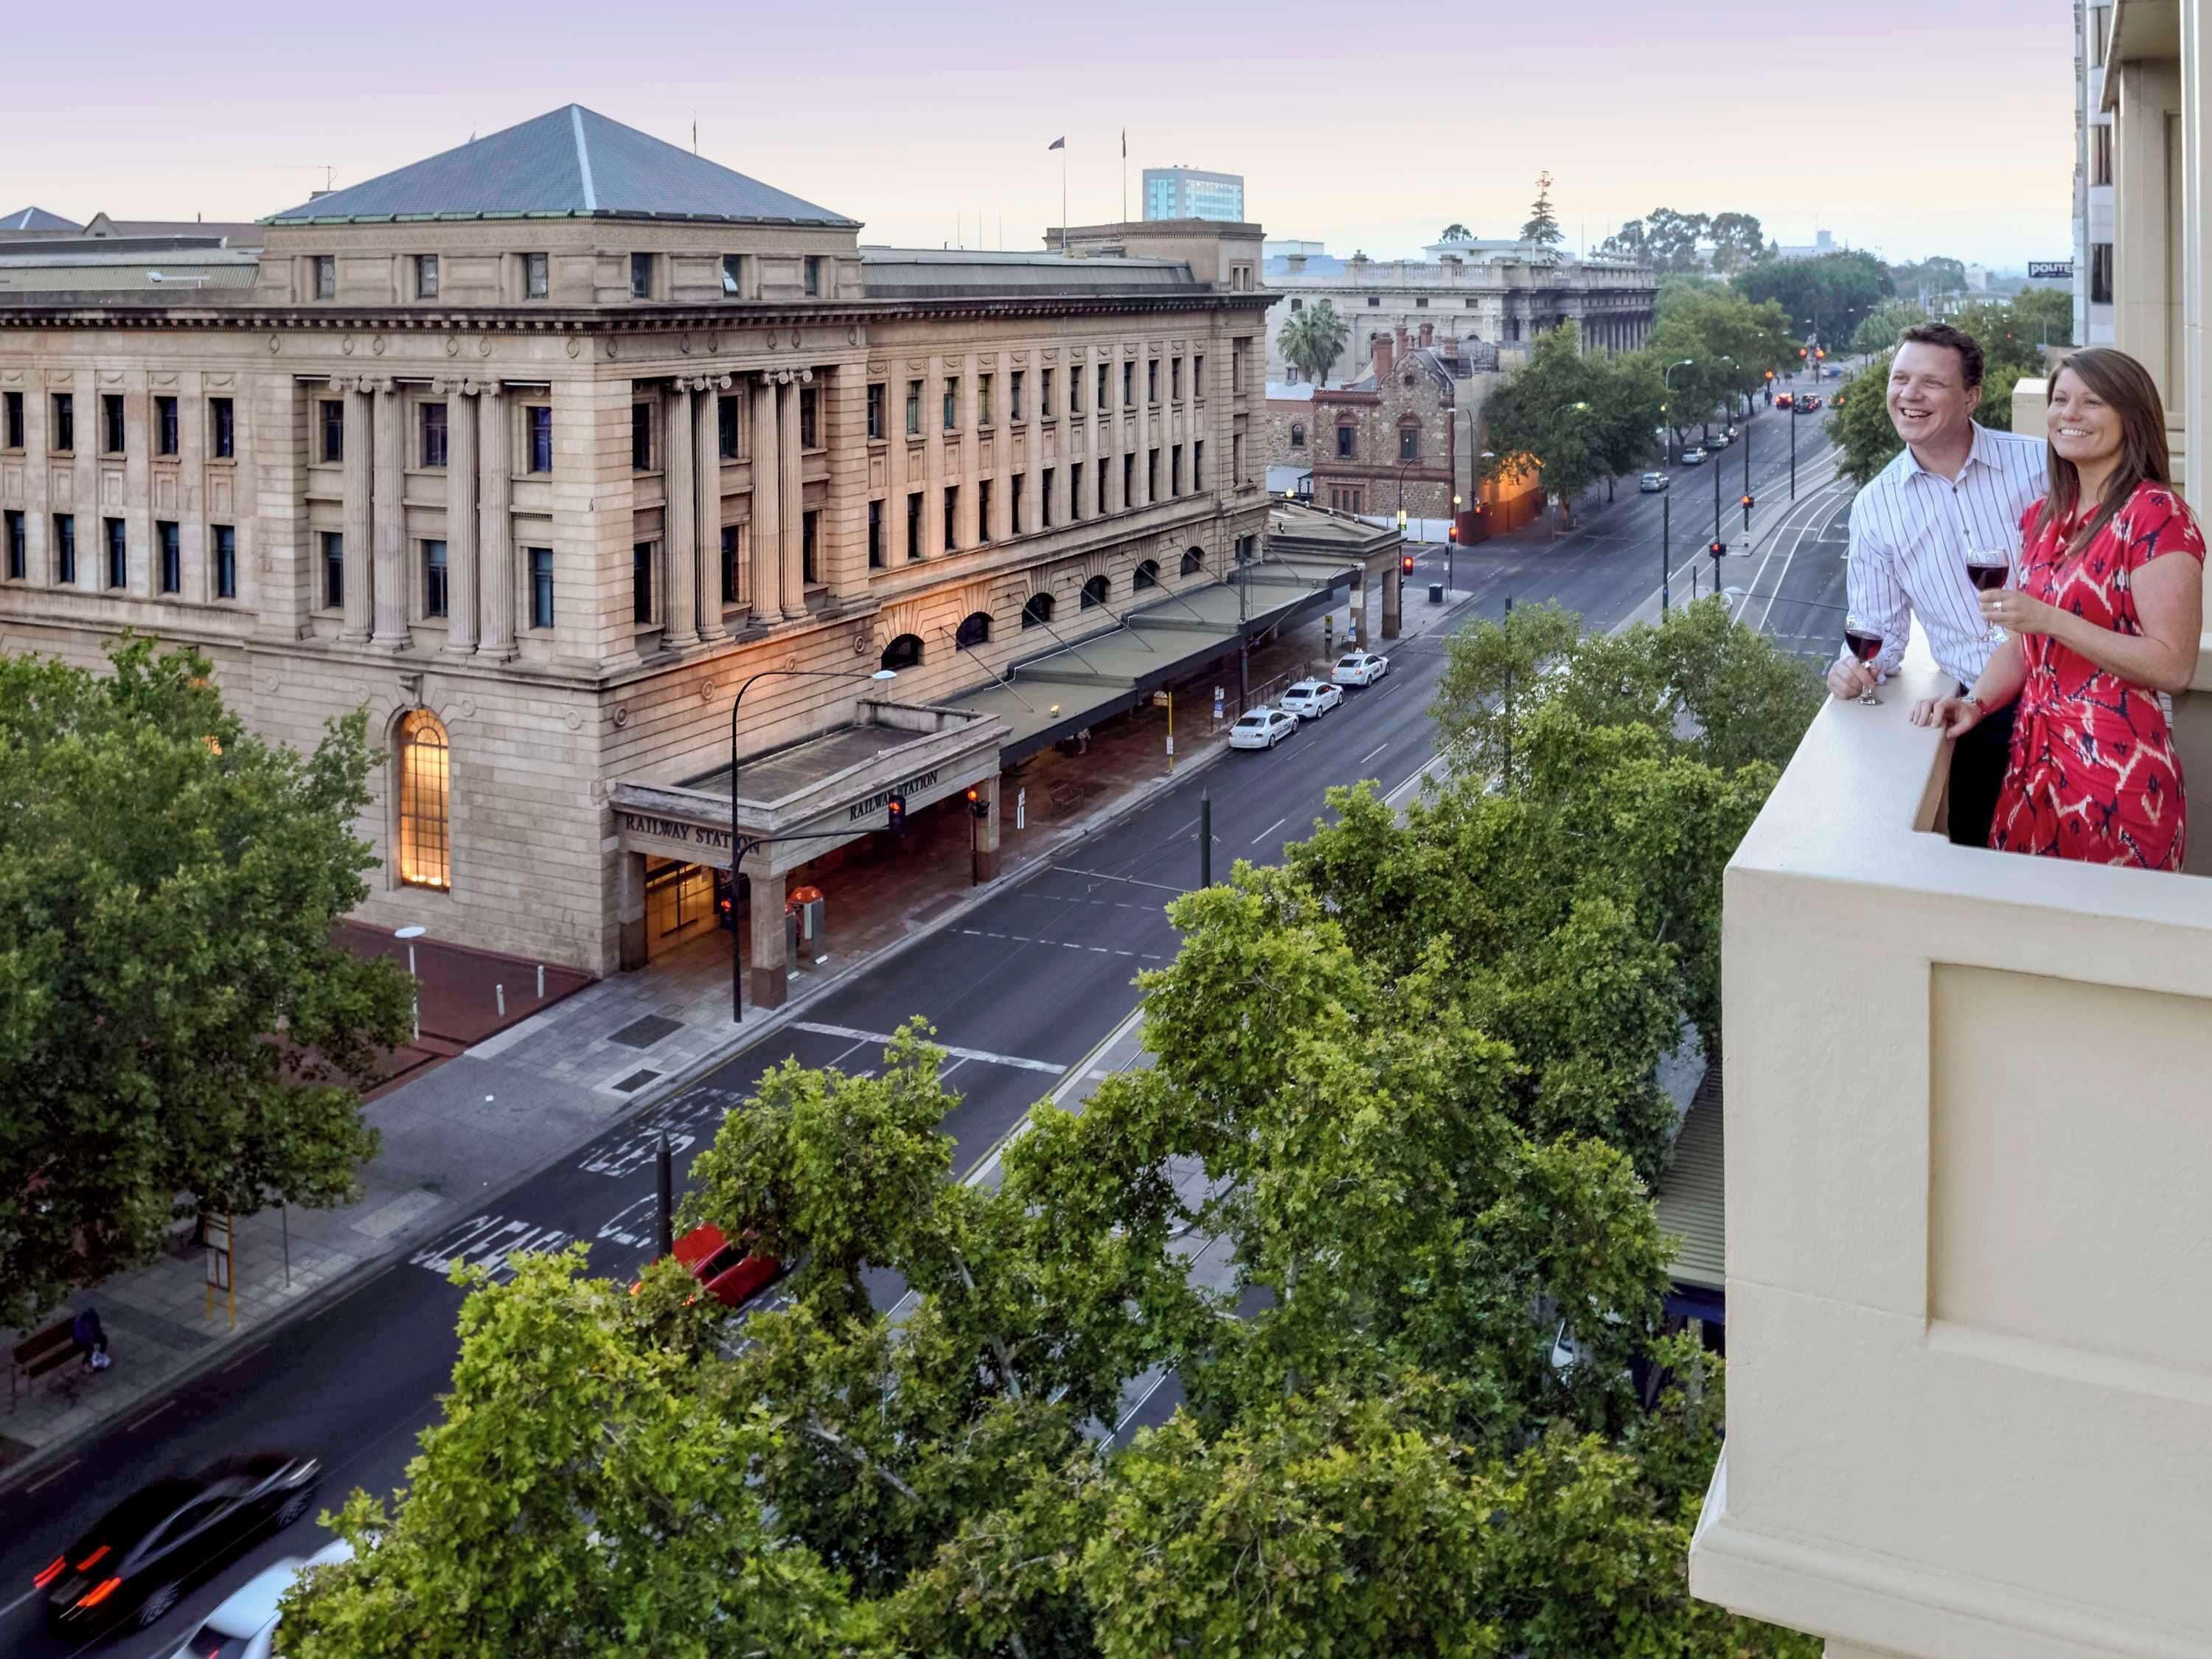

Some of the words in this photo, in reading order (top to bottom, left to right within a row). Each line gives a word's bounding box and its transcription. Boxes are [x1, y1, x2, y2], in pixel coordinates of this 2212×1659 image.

[902, 770, 938, 796] TATION
[626, 814, 690, 841] RAILWAY
[695, 828, 761, 855] STATON
